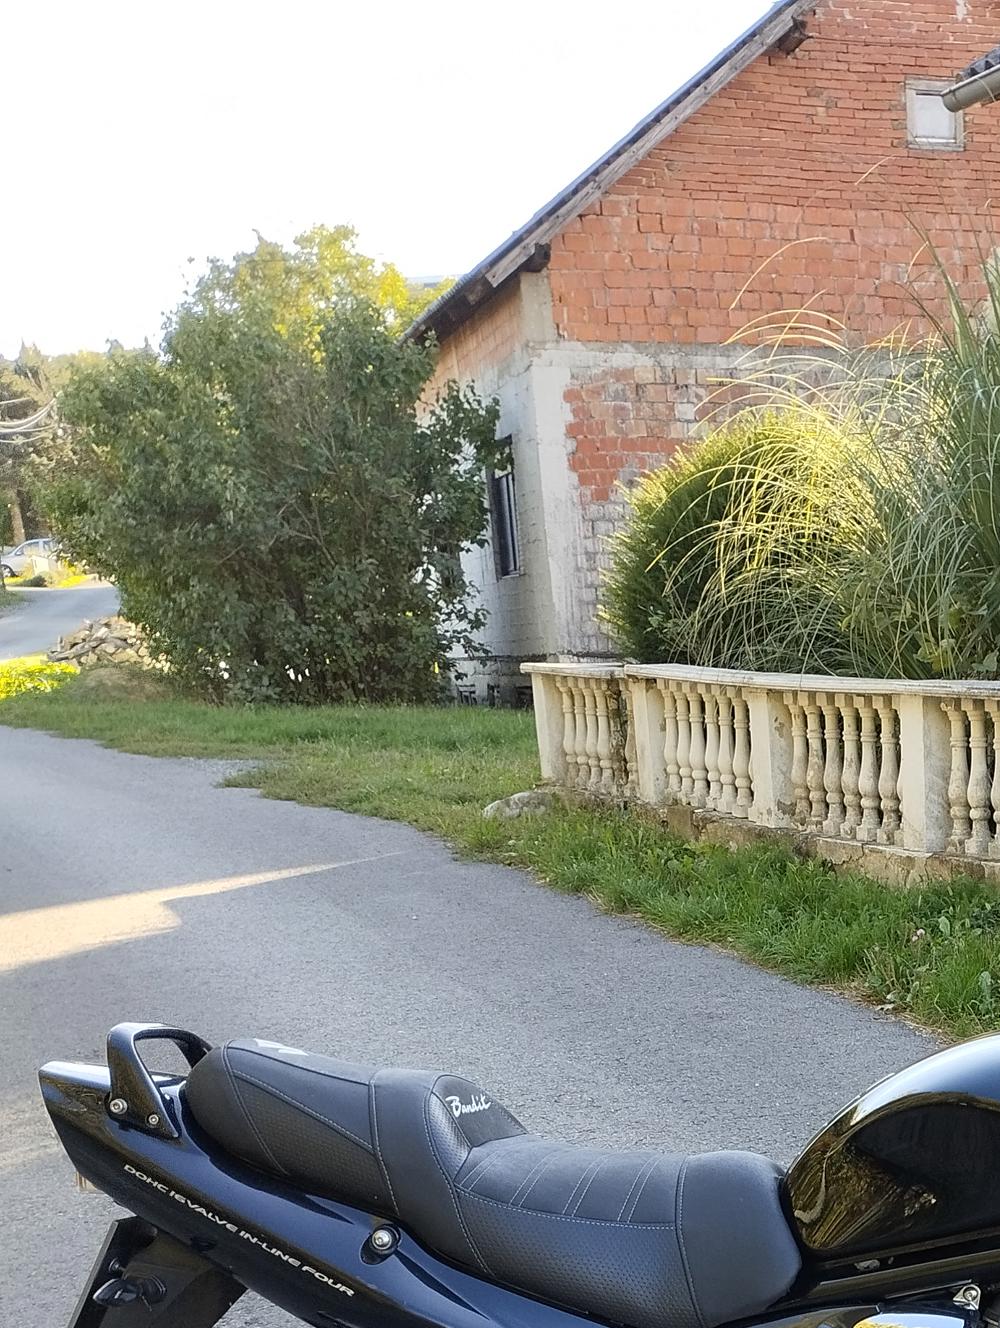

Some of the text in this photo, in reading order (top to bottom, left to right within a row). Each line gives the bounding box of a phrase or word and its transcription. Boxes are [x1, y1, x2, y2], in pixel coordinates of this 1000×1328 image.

[445, 1093, 491, 1118] Bandit
[123, 1164, 169, 1193] DOHC
[239, 1230, 302, 1268] IN-LINE
[301, 1265, 355, 1297] FOUR
